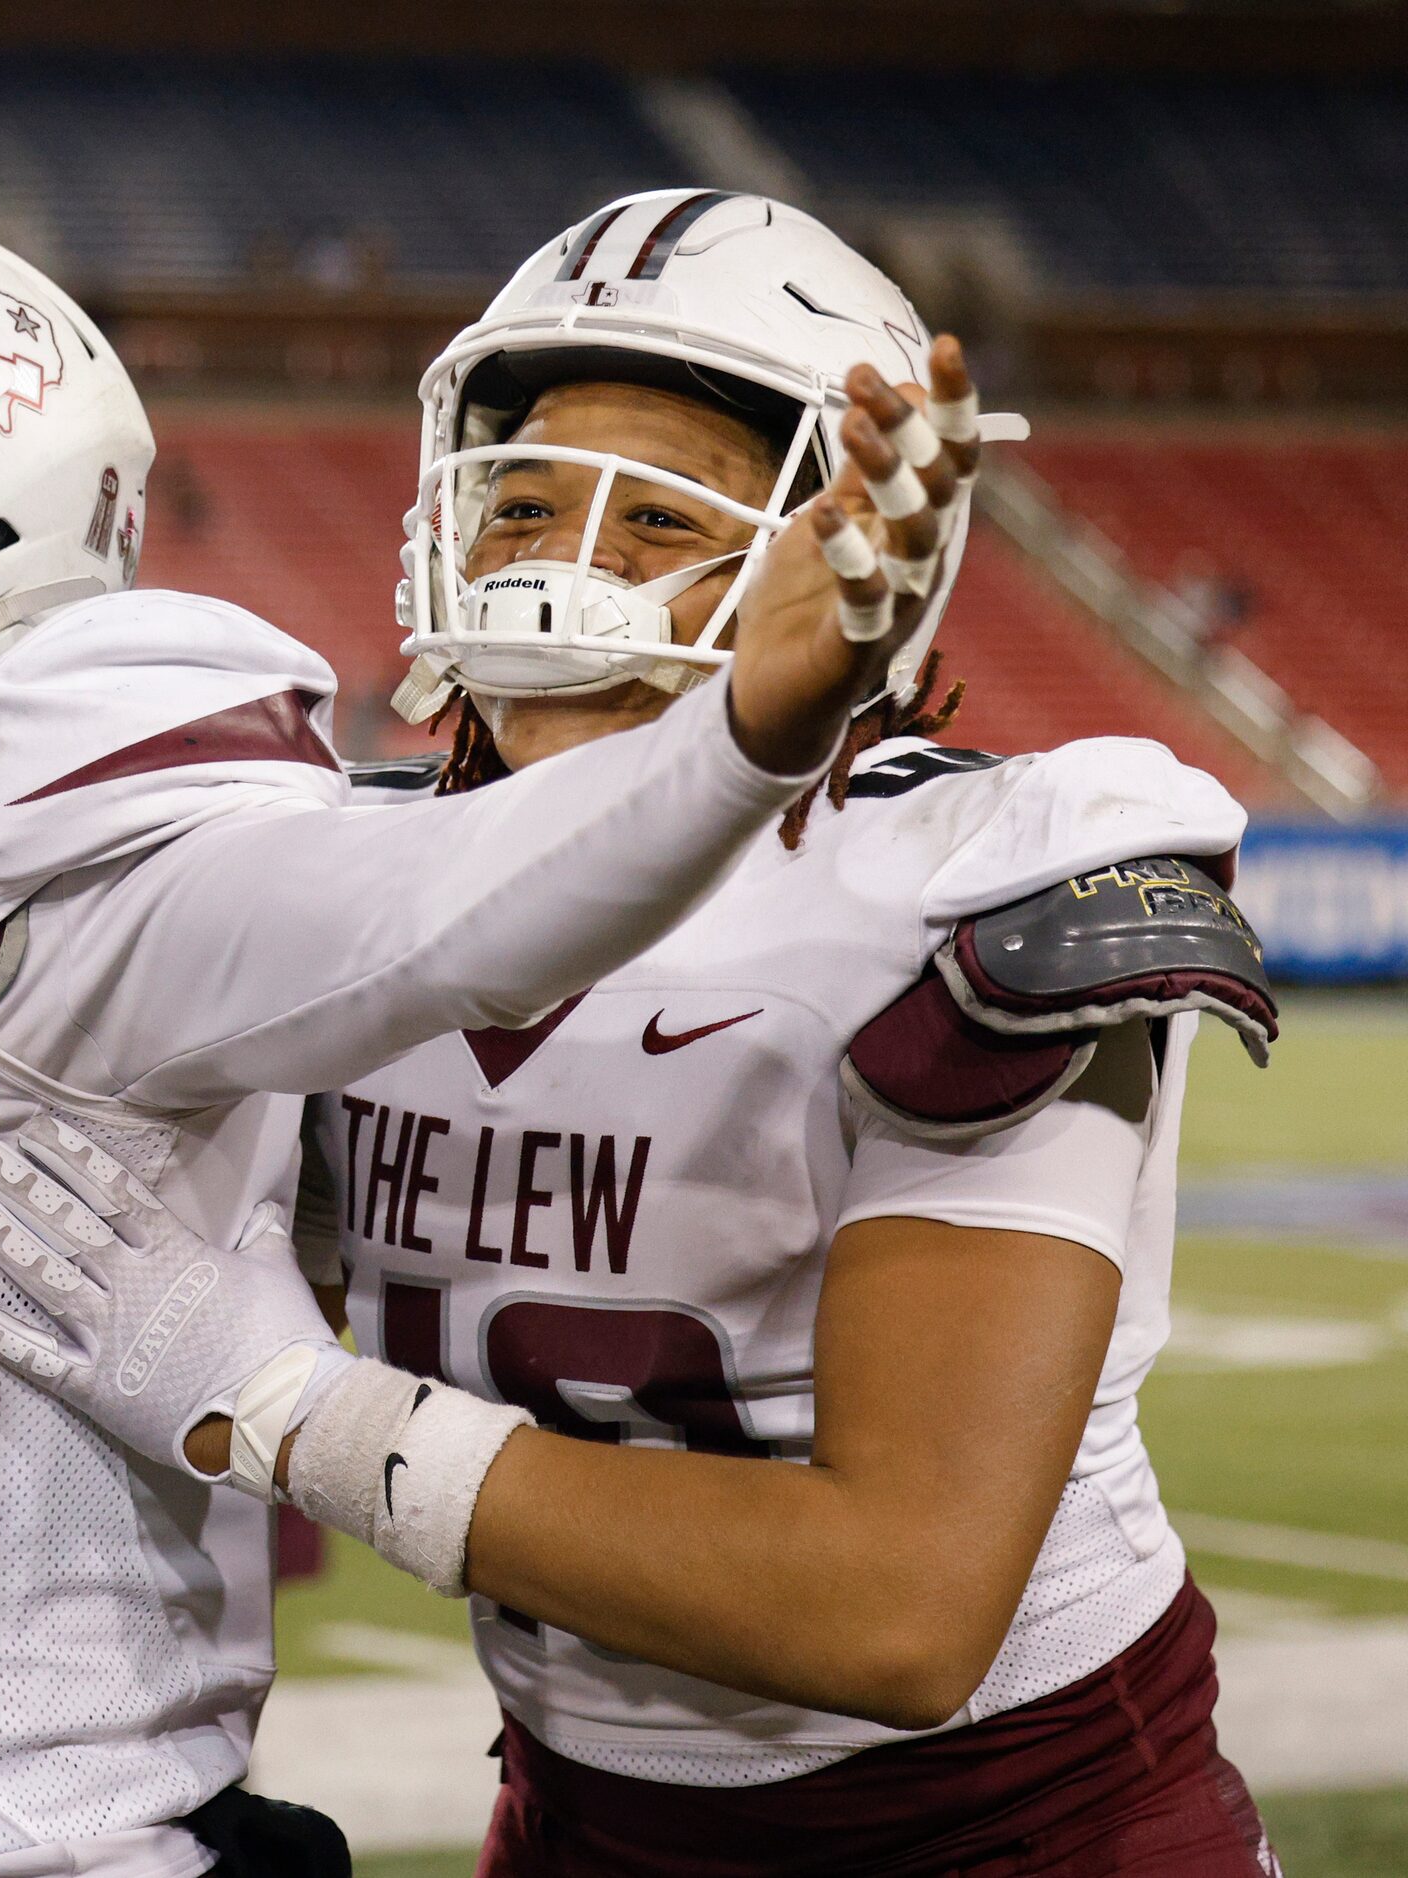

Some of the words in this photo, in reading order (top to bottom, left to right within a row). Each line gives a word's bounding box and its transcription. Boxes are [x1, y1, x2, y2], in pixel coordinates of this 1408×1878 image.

[484, 577, 546, 593] Riddell
[342, 1093, 450, 1254] THE
[465, 1126, 652, 1275] LEW
[126, 1272, 209, 1382] BATTLE
